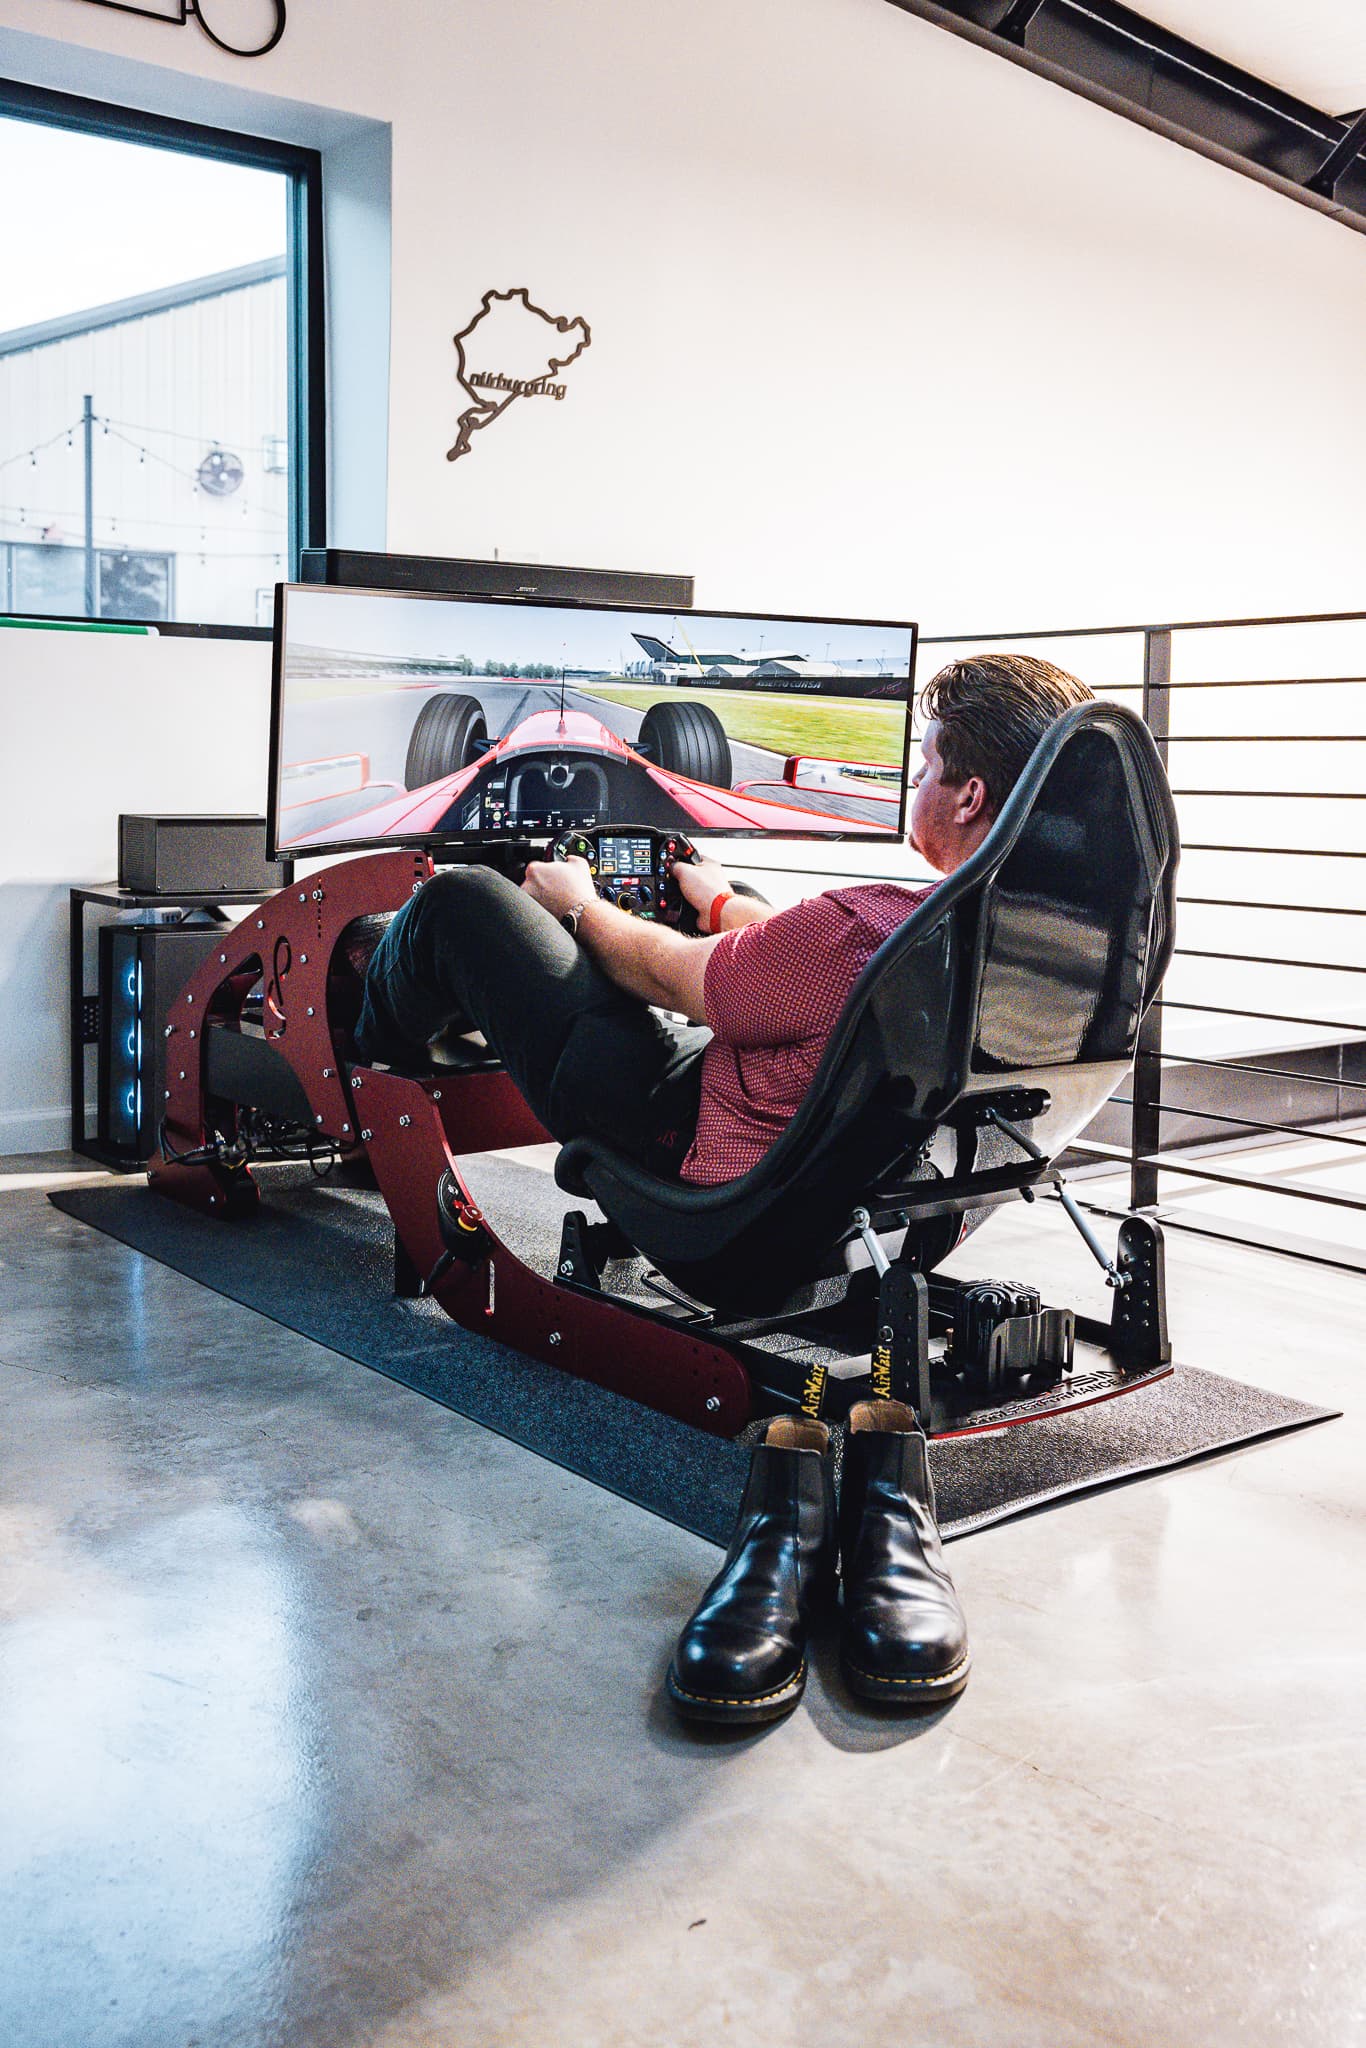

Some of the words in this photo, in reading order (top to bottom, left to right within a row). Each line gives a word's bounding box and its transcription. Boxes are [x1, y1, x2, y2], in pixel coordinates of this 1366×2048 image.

[619, 850, 631, 863] 3
[801, 1363, 825, 1418] AirWair
[872, 1345, 891, 1399] AirWair
